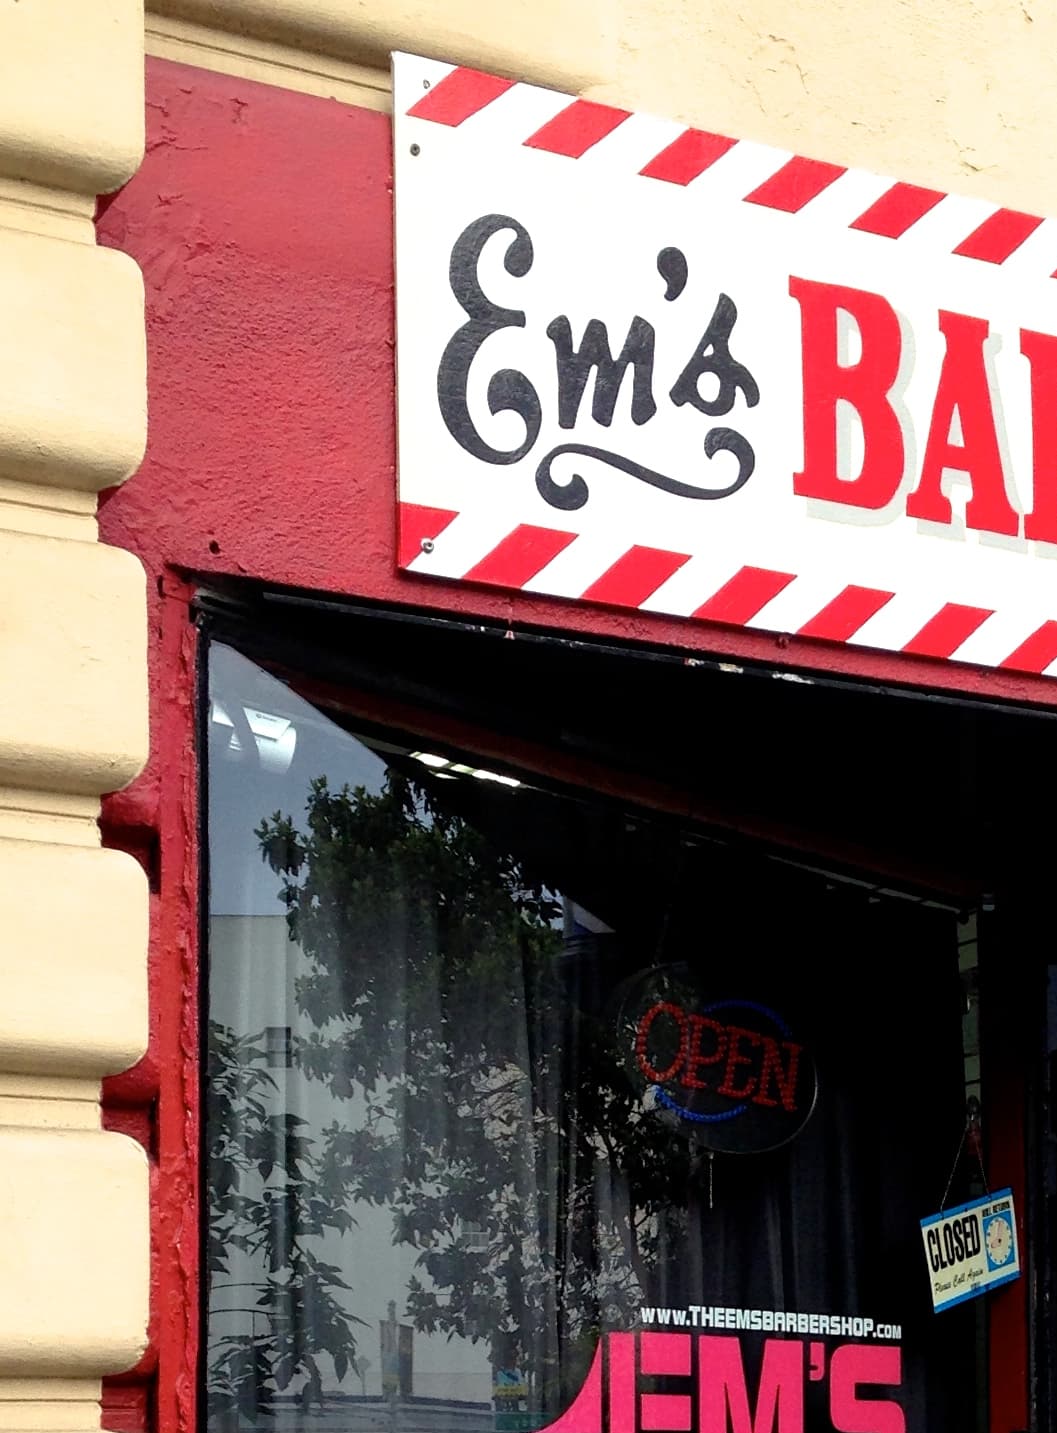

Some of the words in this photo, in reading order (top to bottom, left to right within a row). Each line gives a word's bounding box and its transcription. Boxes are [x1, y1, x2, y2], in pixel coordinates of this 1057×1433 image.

[436, 213, 761, 468] Em's
[634, 1000, 803, 1112] OPEN
[926, 1213, 981, 1273] CLOSED
